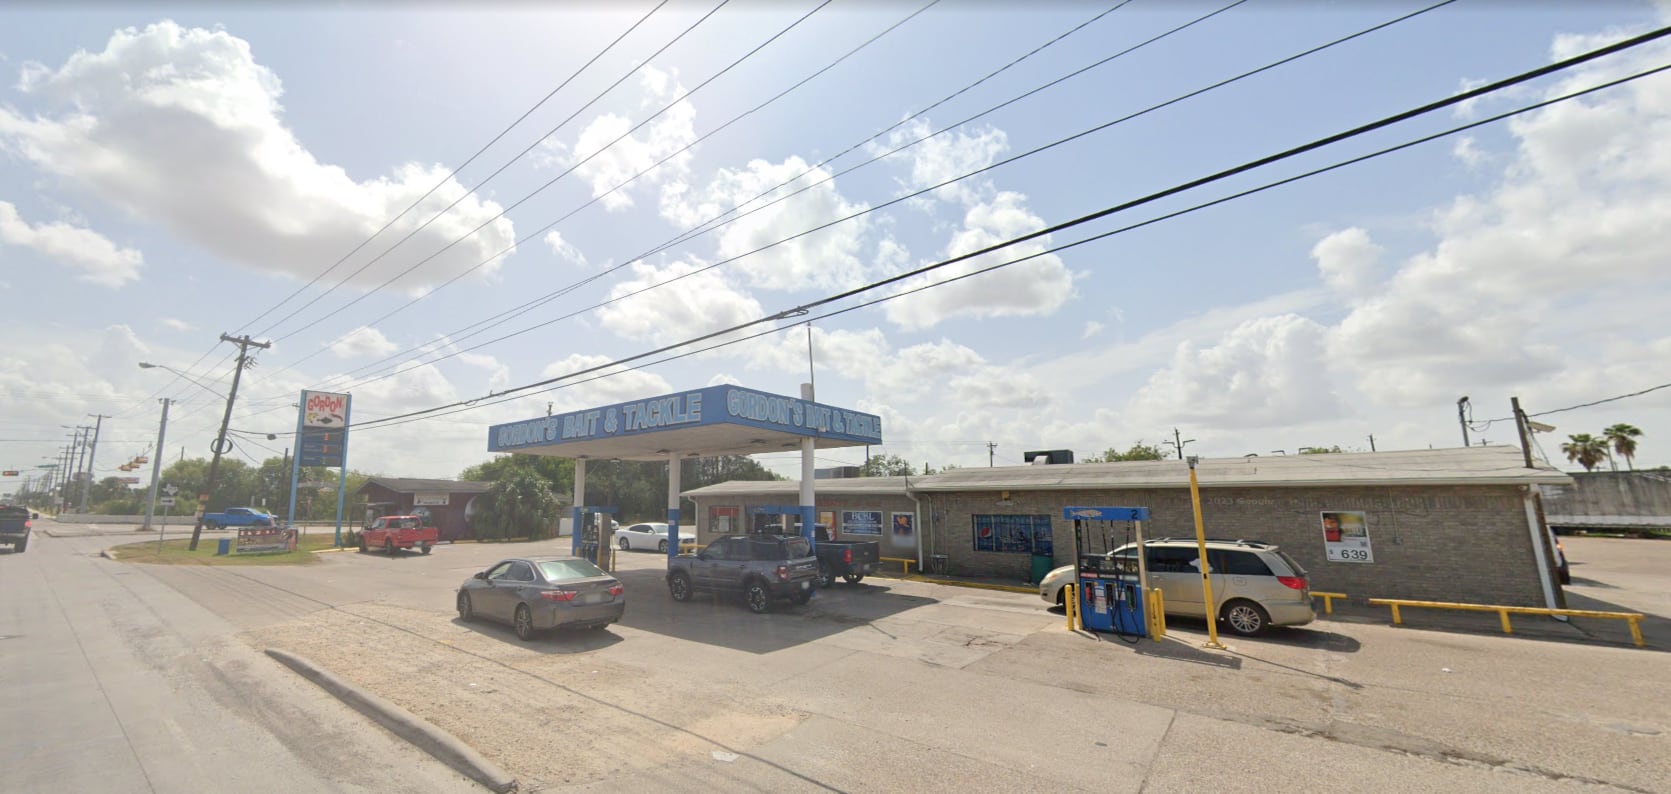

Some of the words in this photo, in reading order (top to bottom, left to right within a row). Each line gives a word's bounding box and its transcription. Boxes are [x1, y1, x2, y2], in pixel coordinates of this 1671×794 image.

[498, 417, 558, 447] GORDON'S
[561, 410, 600, 440] BAIT
[604, 407, 619, 434] &
[623, 392, 703, 433] TACKLE
[727, 389, 803, 427] GORDON'S
[805, 403, 832, 431] BAIT
[832, 410, 845, 433] &
[844, 411, 881, 438] TACKLE
[1130, 509, 1138, 519] 2
[1341, 549, 1368, 560] 639
